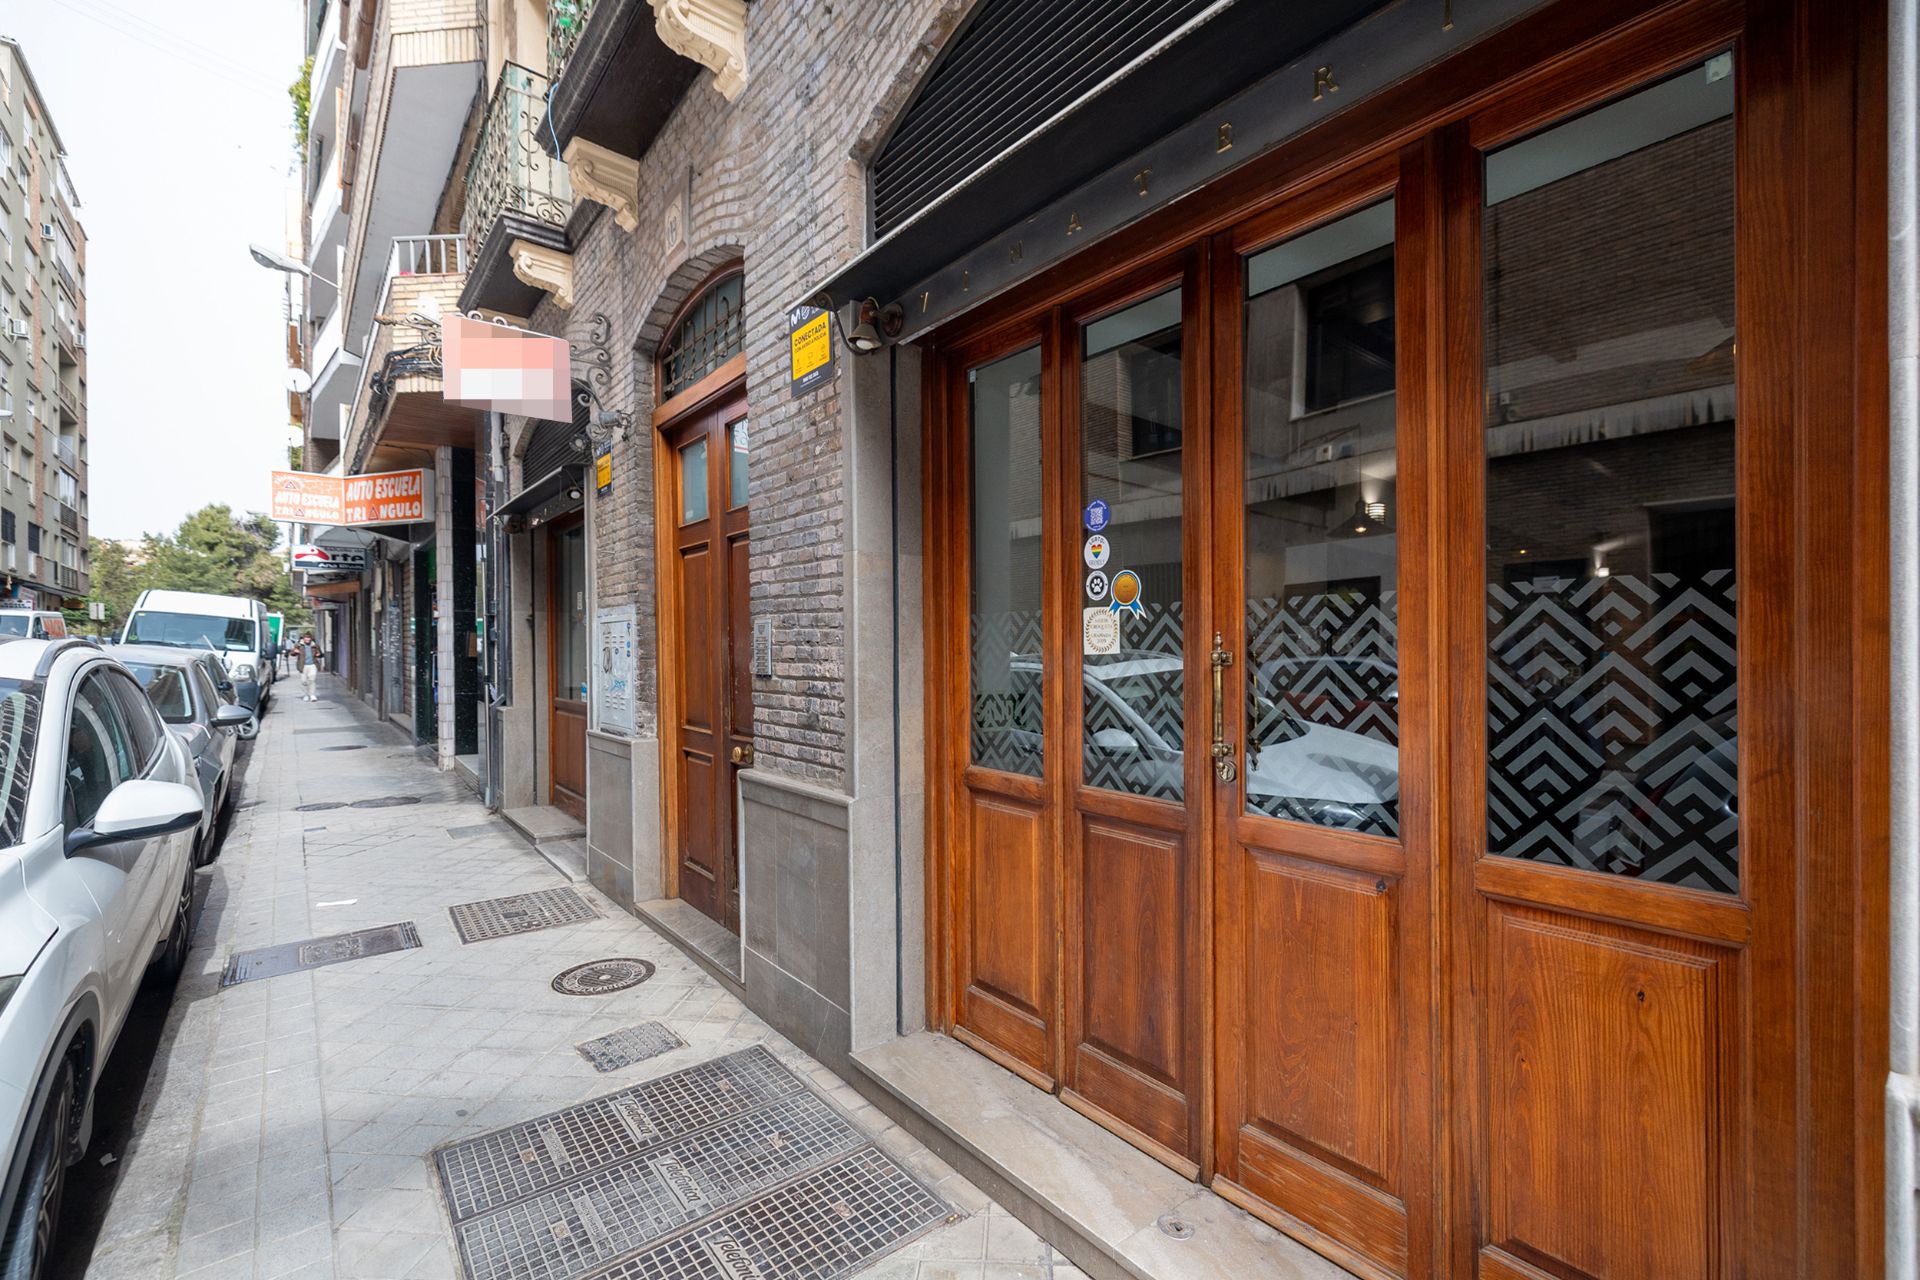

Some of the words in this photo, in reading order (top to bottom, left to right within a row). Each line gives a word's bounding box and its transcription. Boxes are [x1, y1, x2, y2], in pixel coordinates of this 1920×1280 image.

[794, 321, 827, 347] CONECTADA
[346, 479, 373, 501] AUTO
[375, 475, 421, 499] ESCUELA
